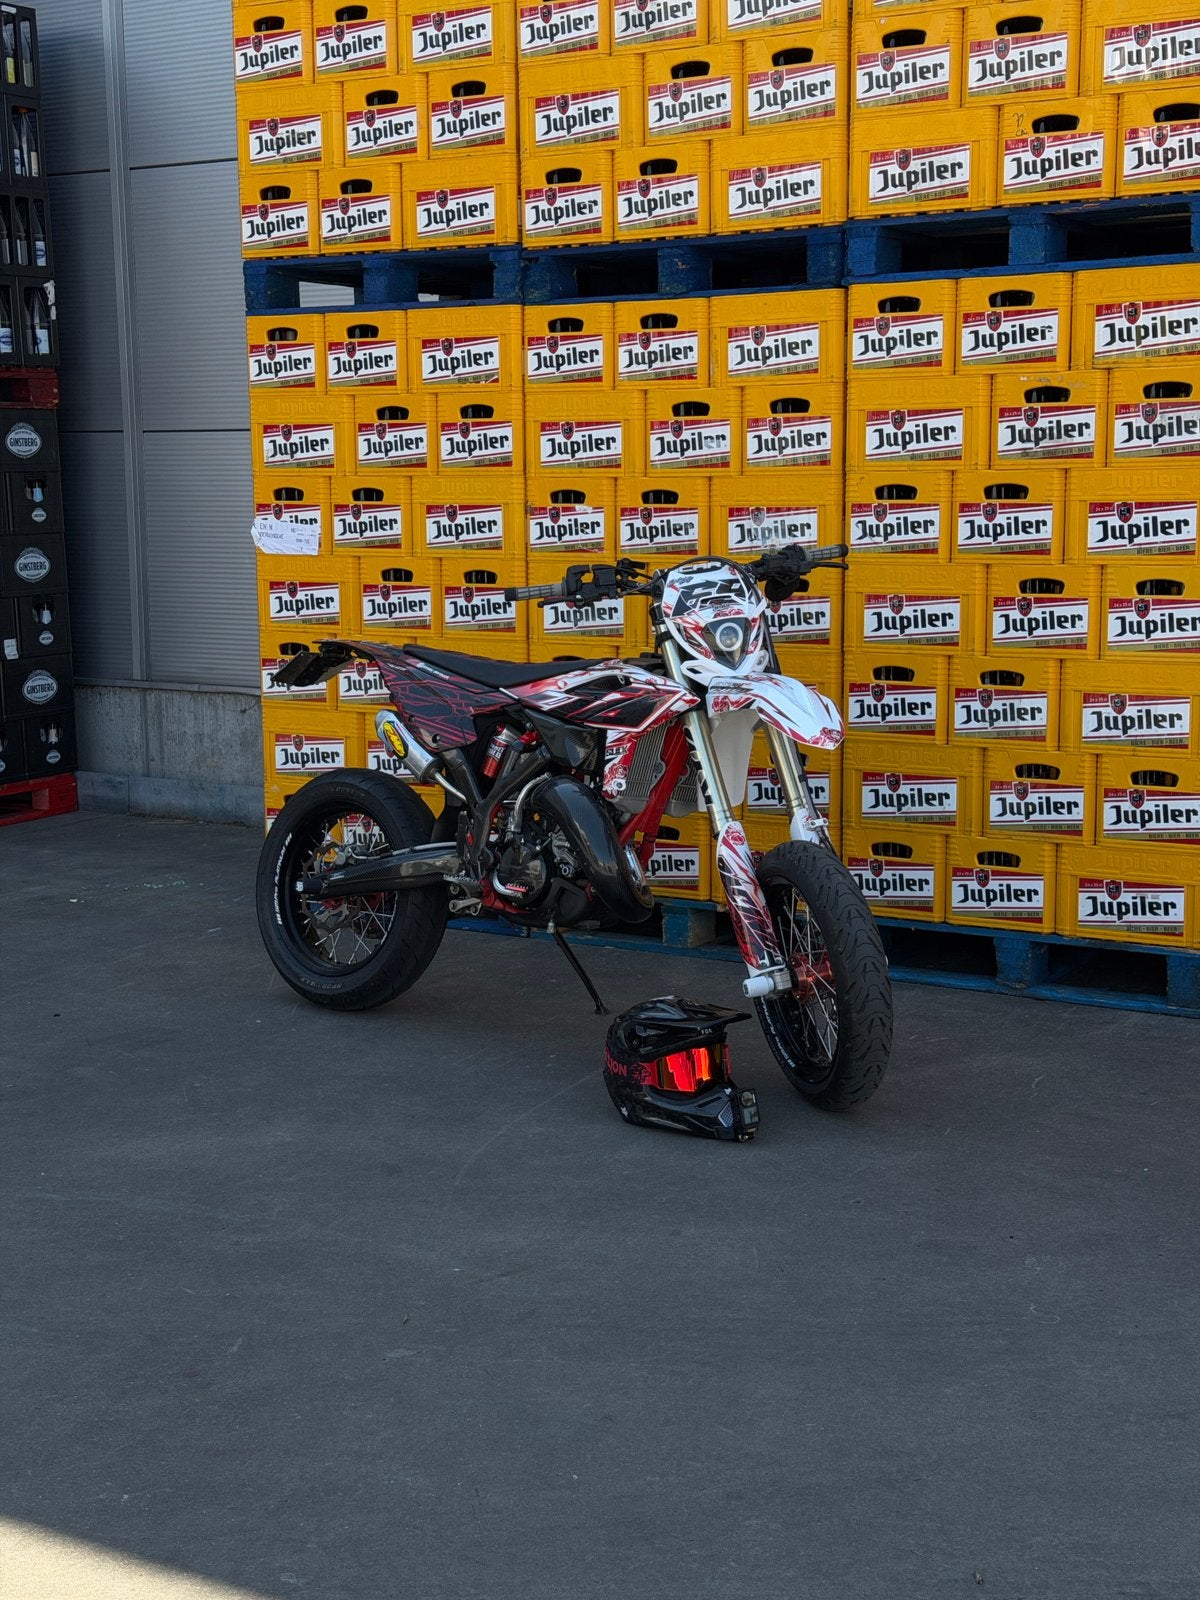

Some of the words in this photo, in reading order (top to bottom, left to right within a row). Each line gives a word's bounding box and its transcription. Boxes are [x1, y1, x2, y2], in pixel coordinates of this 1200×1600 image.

[525, 13, 594, 44] Jupiler
[620, 2, 693, 32] Jupiler
[321, 33, 382, 62] Jupiler
[418, 22, 486, 53] Jupiler
[240, 45, 299, 71] Jupiler
[975, 49, 1062, 82] Jupiler
[862, 60, 944, 94] Jupiler
[653, 91, 726, 123] Jupiler
[753, 78, 831, 111] Jupiler
[352, 120, 413, 146] Jupiler
[436, 110, 501, 138] Jupiler
[541, 104, 613, 136] Jupiler
[255, 128, 316, 155] Jupiler
[1010, 148, 1098, 180] Jupiler
[877, 161, 963, 194] Jupiler
[623, 189, 694, 219] Jupiler
[734, 177, 814, 210] Jupiler
[327, 206, 387, 232] Jupiler
[423, 200, 489, 228] Jupiler
[530, 199, 598, 226] Jupiler
[247, 214, 304, 239] Jupiler
[858, 329, 938, 356] Jupiler
[968, 323, 1052, 352] Jupiler
[1103, 316, 1198, 348] Jupiler
[333, 353, 393, 376] Jupiler
[428, 349, 494, 375] Jupiler
[532, 348, 599, 372] Jupiler
[624, 343, 694, 370] Jupiler
[734, 337, 812, 368] Jupiler
[254, 357, 312, 377] Jupiler
[10, 437, 38, 447] GINSTBERG
[363, 434, 424, 458] Jupiler
[446, 432, 509, 457] Jupiler
[546, 434, 616, 459] Jupiler
[655, 433, 726, 459] Jupiler
[753, 428, 827, 456] Jupiler
[872, 423, 956, 451] Jupiler
[1004, 419, 1090, 448] Jupiler
[268, 436, 329, 459] Jupiler
[338, 516, 398, 538] Jupiler
[432, 516, 497, 541] Jupiler
[534, 519, 600, 542] Jupiler
[626, 520, 694, 544] Jupiler
[734, 520, 811, 545] Jupiler
[855, 517, 935, 543] Jupiler
[964, 517, 1047, 543] Jupiler
[1095, 517, 1189, 546] Jupiler
[18, 560, 47, 571] GINSTBERG
[274, 596, 334, 616] Jupiler
[368, 598, 427, 618] Jupiler
[449, 599, 511, 621] Jupiler
[549, 605, 619, 627] Jupiler
[766, 608, 826, 632] upiler
[871, 608, 953, 635] Jupiler
[998, 610, 1082, 638] Jupiler
[1114, 613, 1200, 640] Jupiler
[26, 682, 54, 695] GINSTBERG
[343, 674, 383, 695] Jupil
[854, 698, 932, 723] Jupiler
[961, 702, 1042, 728] Jupiler
[1090, 707, 1182, 736] Jupiler
[281, 749, 339, 770] Jupiler
[869, 788, 950, 813] Jupiler
[996, 795, 1079, 822] Jupiler
[1109, 803, 1199, 830] Jupiler
[648, 854, 695, 877] piler
[958, 884, 1038, 910] Jupiler
[1085, 896, 1176, 922] Jupiler
